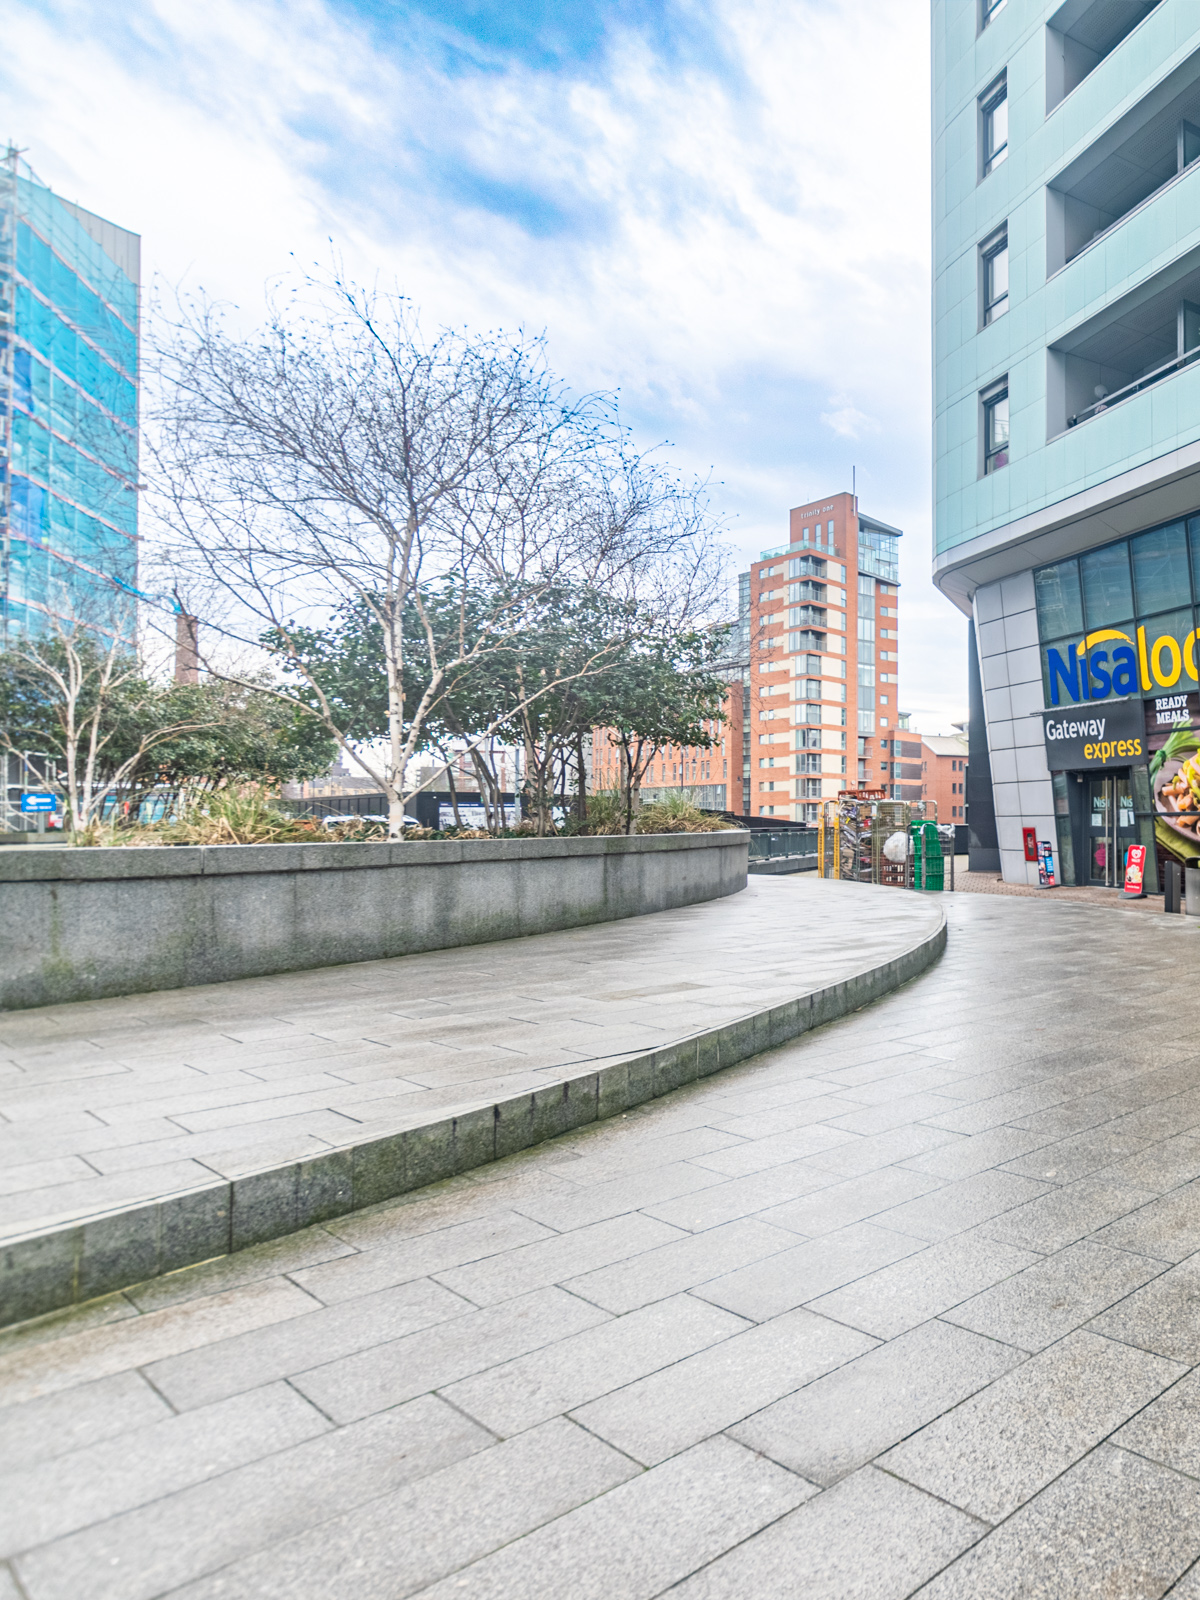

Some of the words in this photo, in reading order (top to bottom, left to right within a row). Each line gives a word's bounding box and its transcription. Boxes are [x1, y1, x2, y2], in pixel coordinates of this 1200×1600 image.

[1155, 694, 1188, 711] READY
[1156, 708, 1190, 724] MEALS
[1046, 718, 1106, 740] Gateway
[1084, 738, 1142, 763] express
